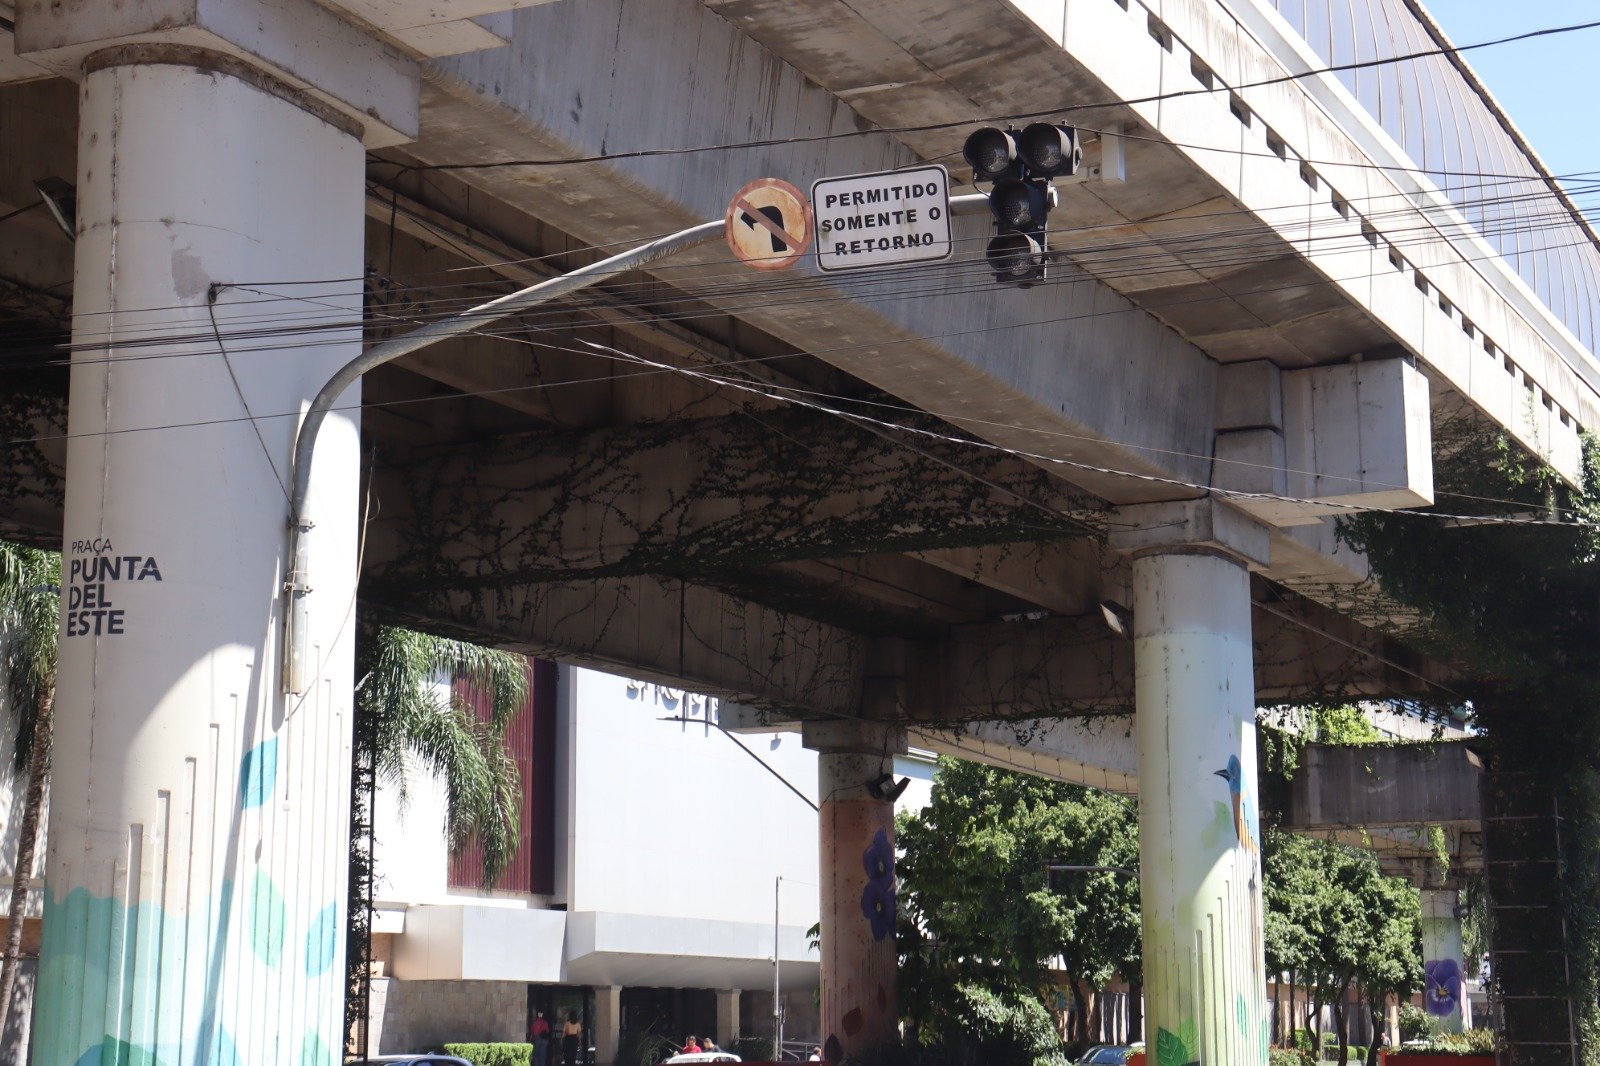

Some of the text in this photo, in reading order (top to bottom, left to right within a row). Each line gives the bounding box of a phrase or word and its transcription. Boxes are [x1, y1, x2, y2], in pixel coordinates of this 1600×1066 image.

[825, 182, 938, 209] PERMITIDO
[821, 207, 942, 233] SOMENTE O
[835, 232, 934, 256] RETORNO
[72, 538, 113, 556] PRAÇA
[70, 556, 163, 583] PUNTA
[68, 583, 112, 610] DEL
[67, 610, 125, 637] ESTE
